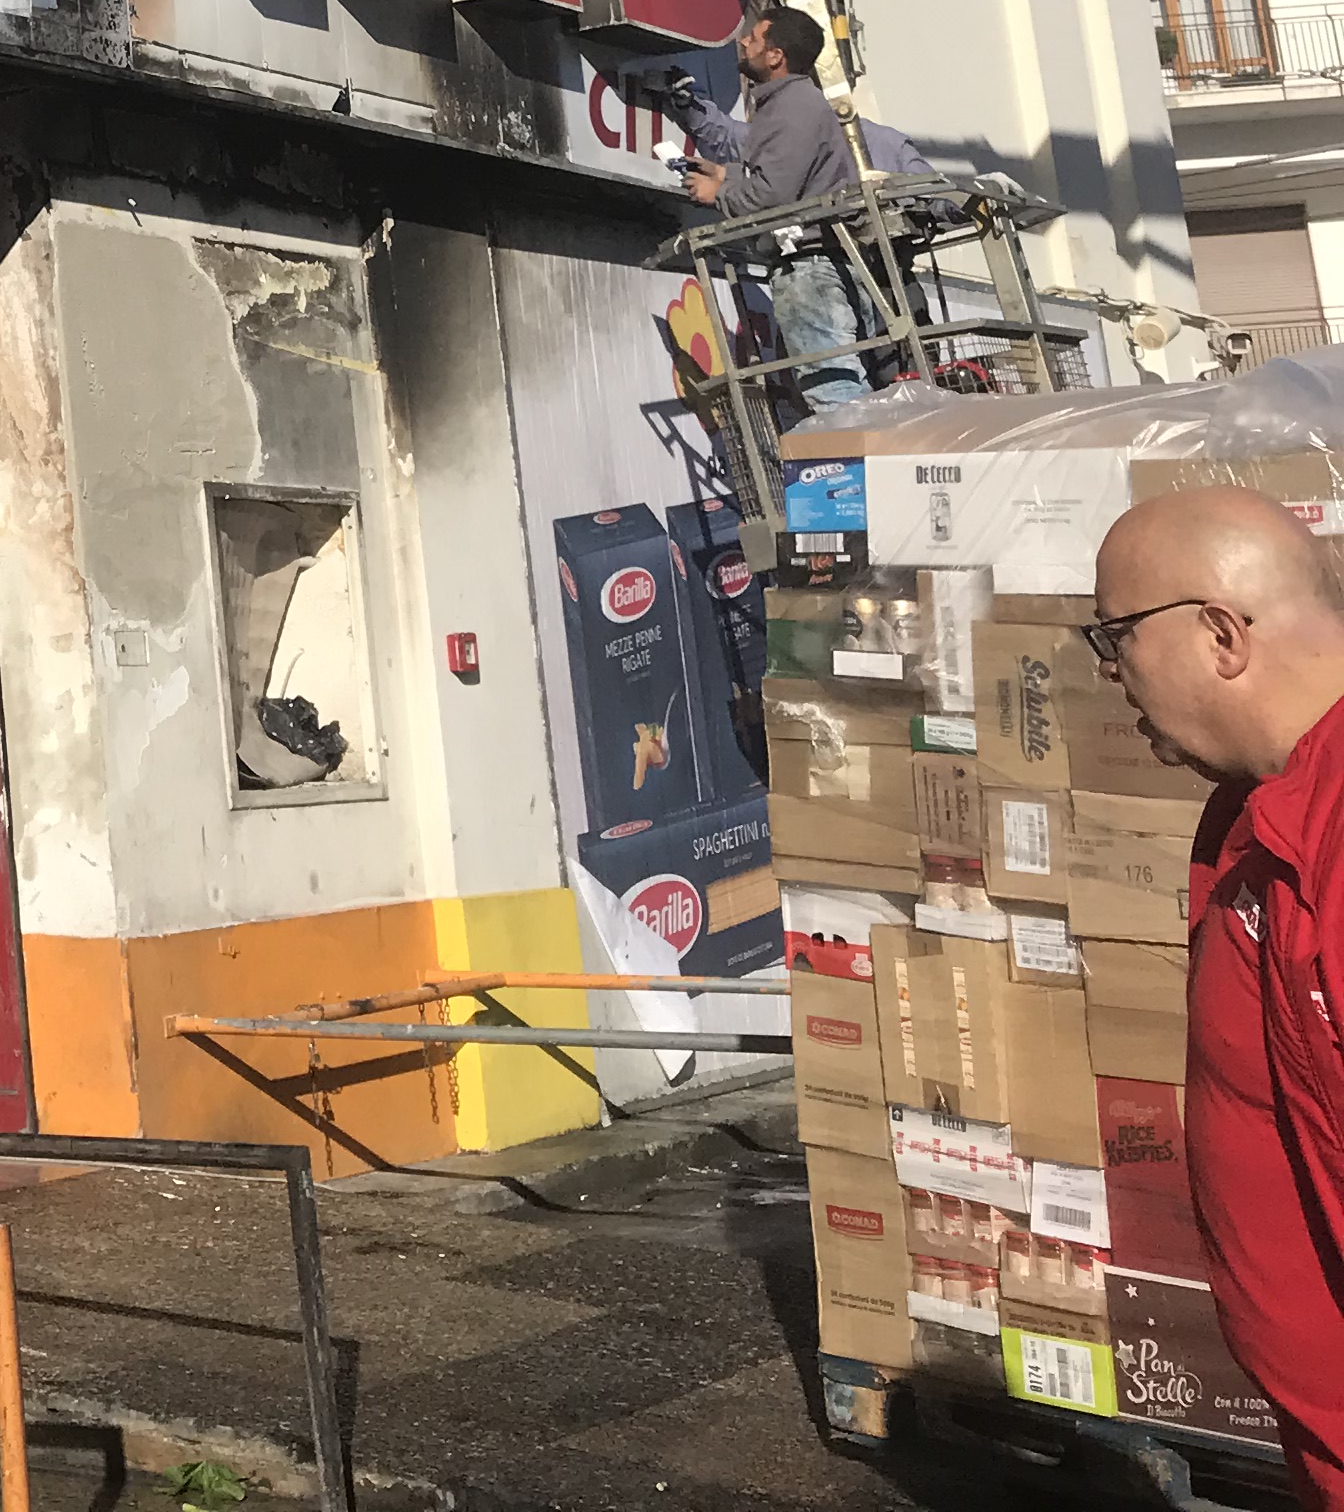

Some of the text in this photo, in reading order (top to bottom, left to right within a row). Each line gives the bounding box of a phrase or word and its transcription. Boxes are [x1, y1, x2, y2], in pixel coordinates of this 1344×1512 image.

[799, 463, 845, 485] OREO
[614, 577, 650, 608] Barilla
[605, 624, 663, 658] MEZZE PENNE
[622, 649, 651, 674] RIGATE
[693, 820, 759, 860] SPAGHETTINI
[1124, 864, 1153, 884] 176
[1118, 1126, 1155, 1145] RICE
[843, 1214, 879, 1230] CONAD
[1139, 1339, 1175, 1377] Pan
[1127, 1372, 1195, 1408] Stelle
[1214, 1396, 1231, 1408] Con
